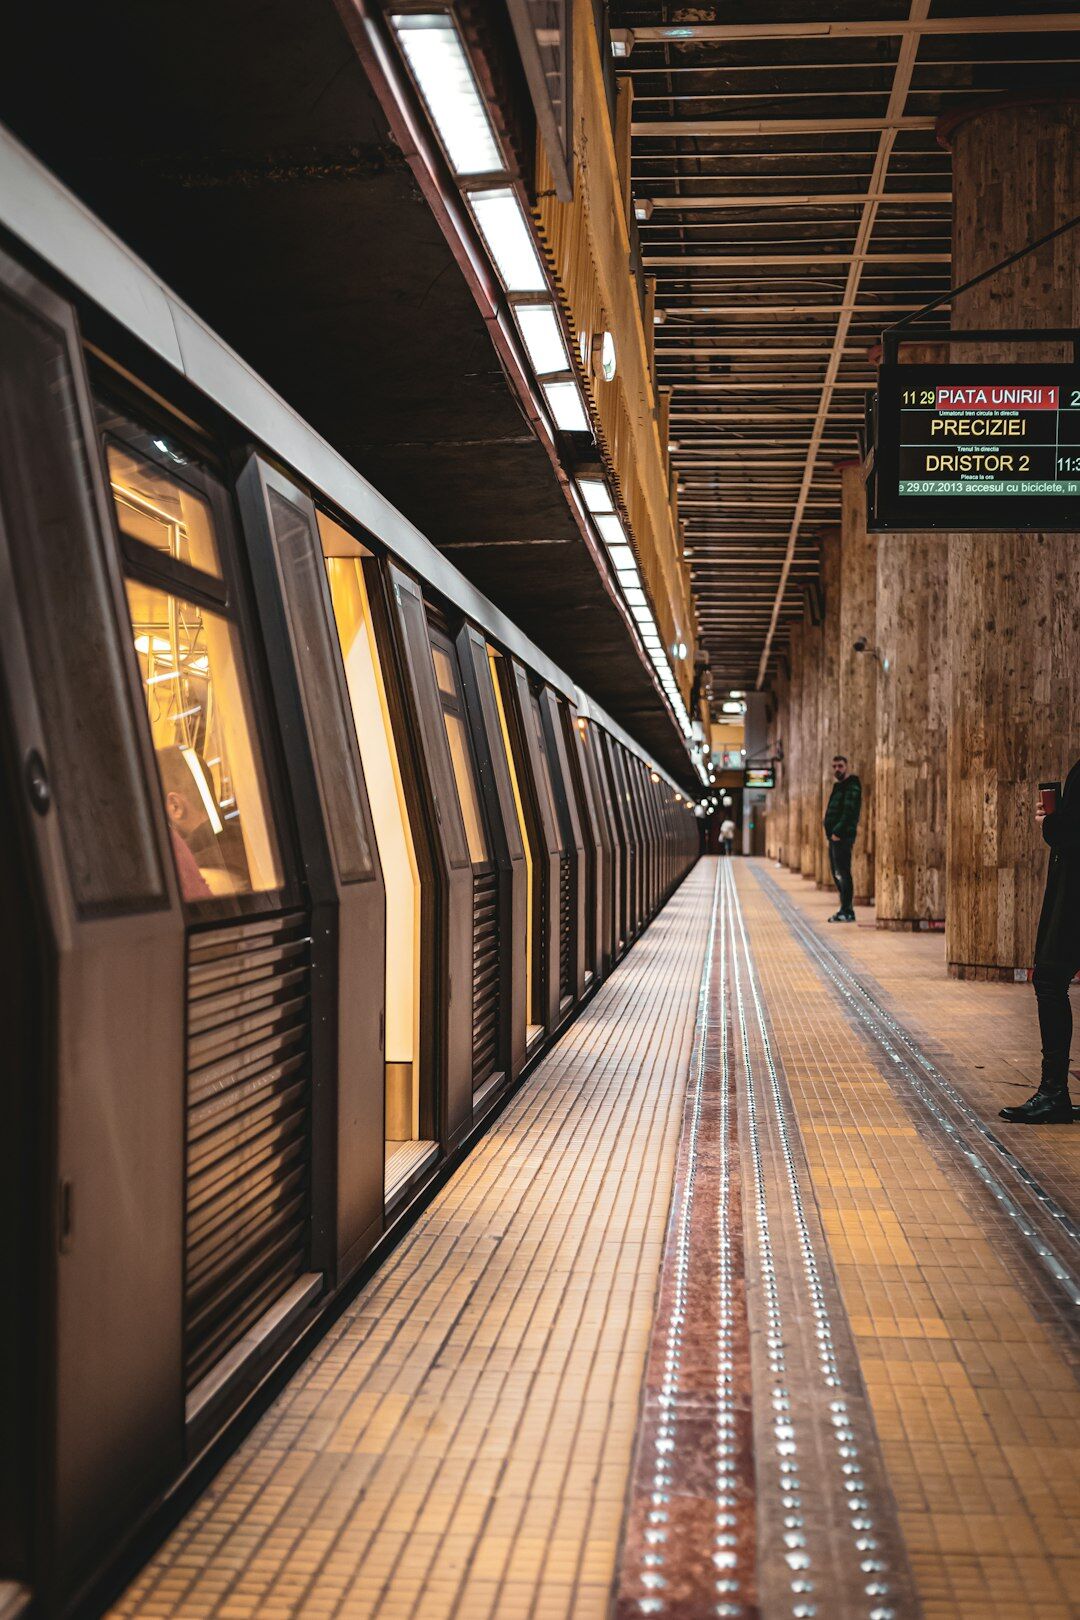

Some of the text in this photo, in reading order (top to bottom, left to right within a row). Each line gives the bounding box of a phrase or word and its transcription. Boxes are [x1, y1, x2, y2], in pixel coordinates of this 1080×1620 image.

[902, 390, 935, 404] 11 29
[938, 389, 1055, 404] PIATA UNIRII 1
[931, 419, 1026, 436] PRECIZIEI
[925, 455, 1030, 472] DRISTOR 2
[907, 482, 963, 492] 29.07.2013
[965, 482, 1004, 492] accesul
[1006, 484, 1018, 492] cu
[1021, 482, 1065, 494] biciclete,
[1068, 482, 1077, 492] in
